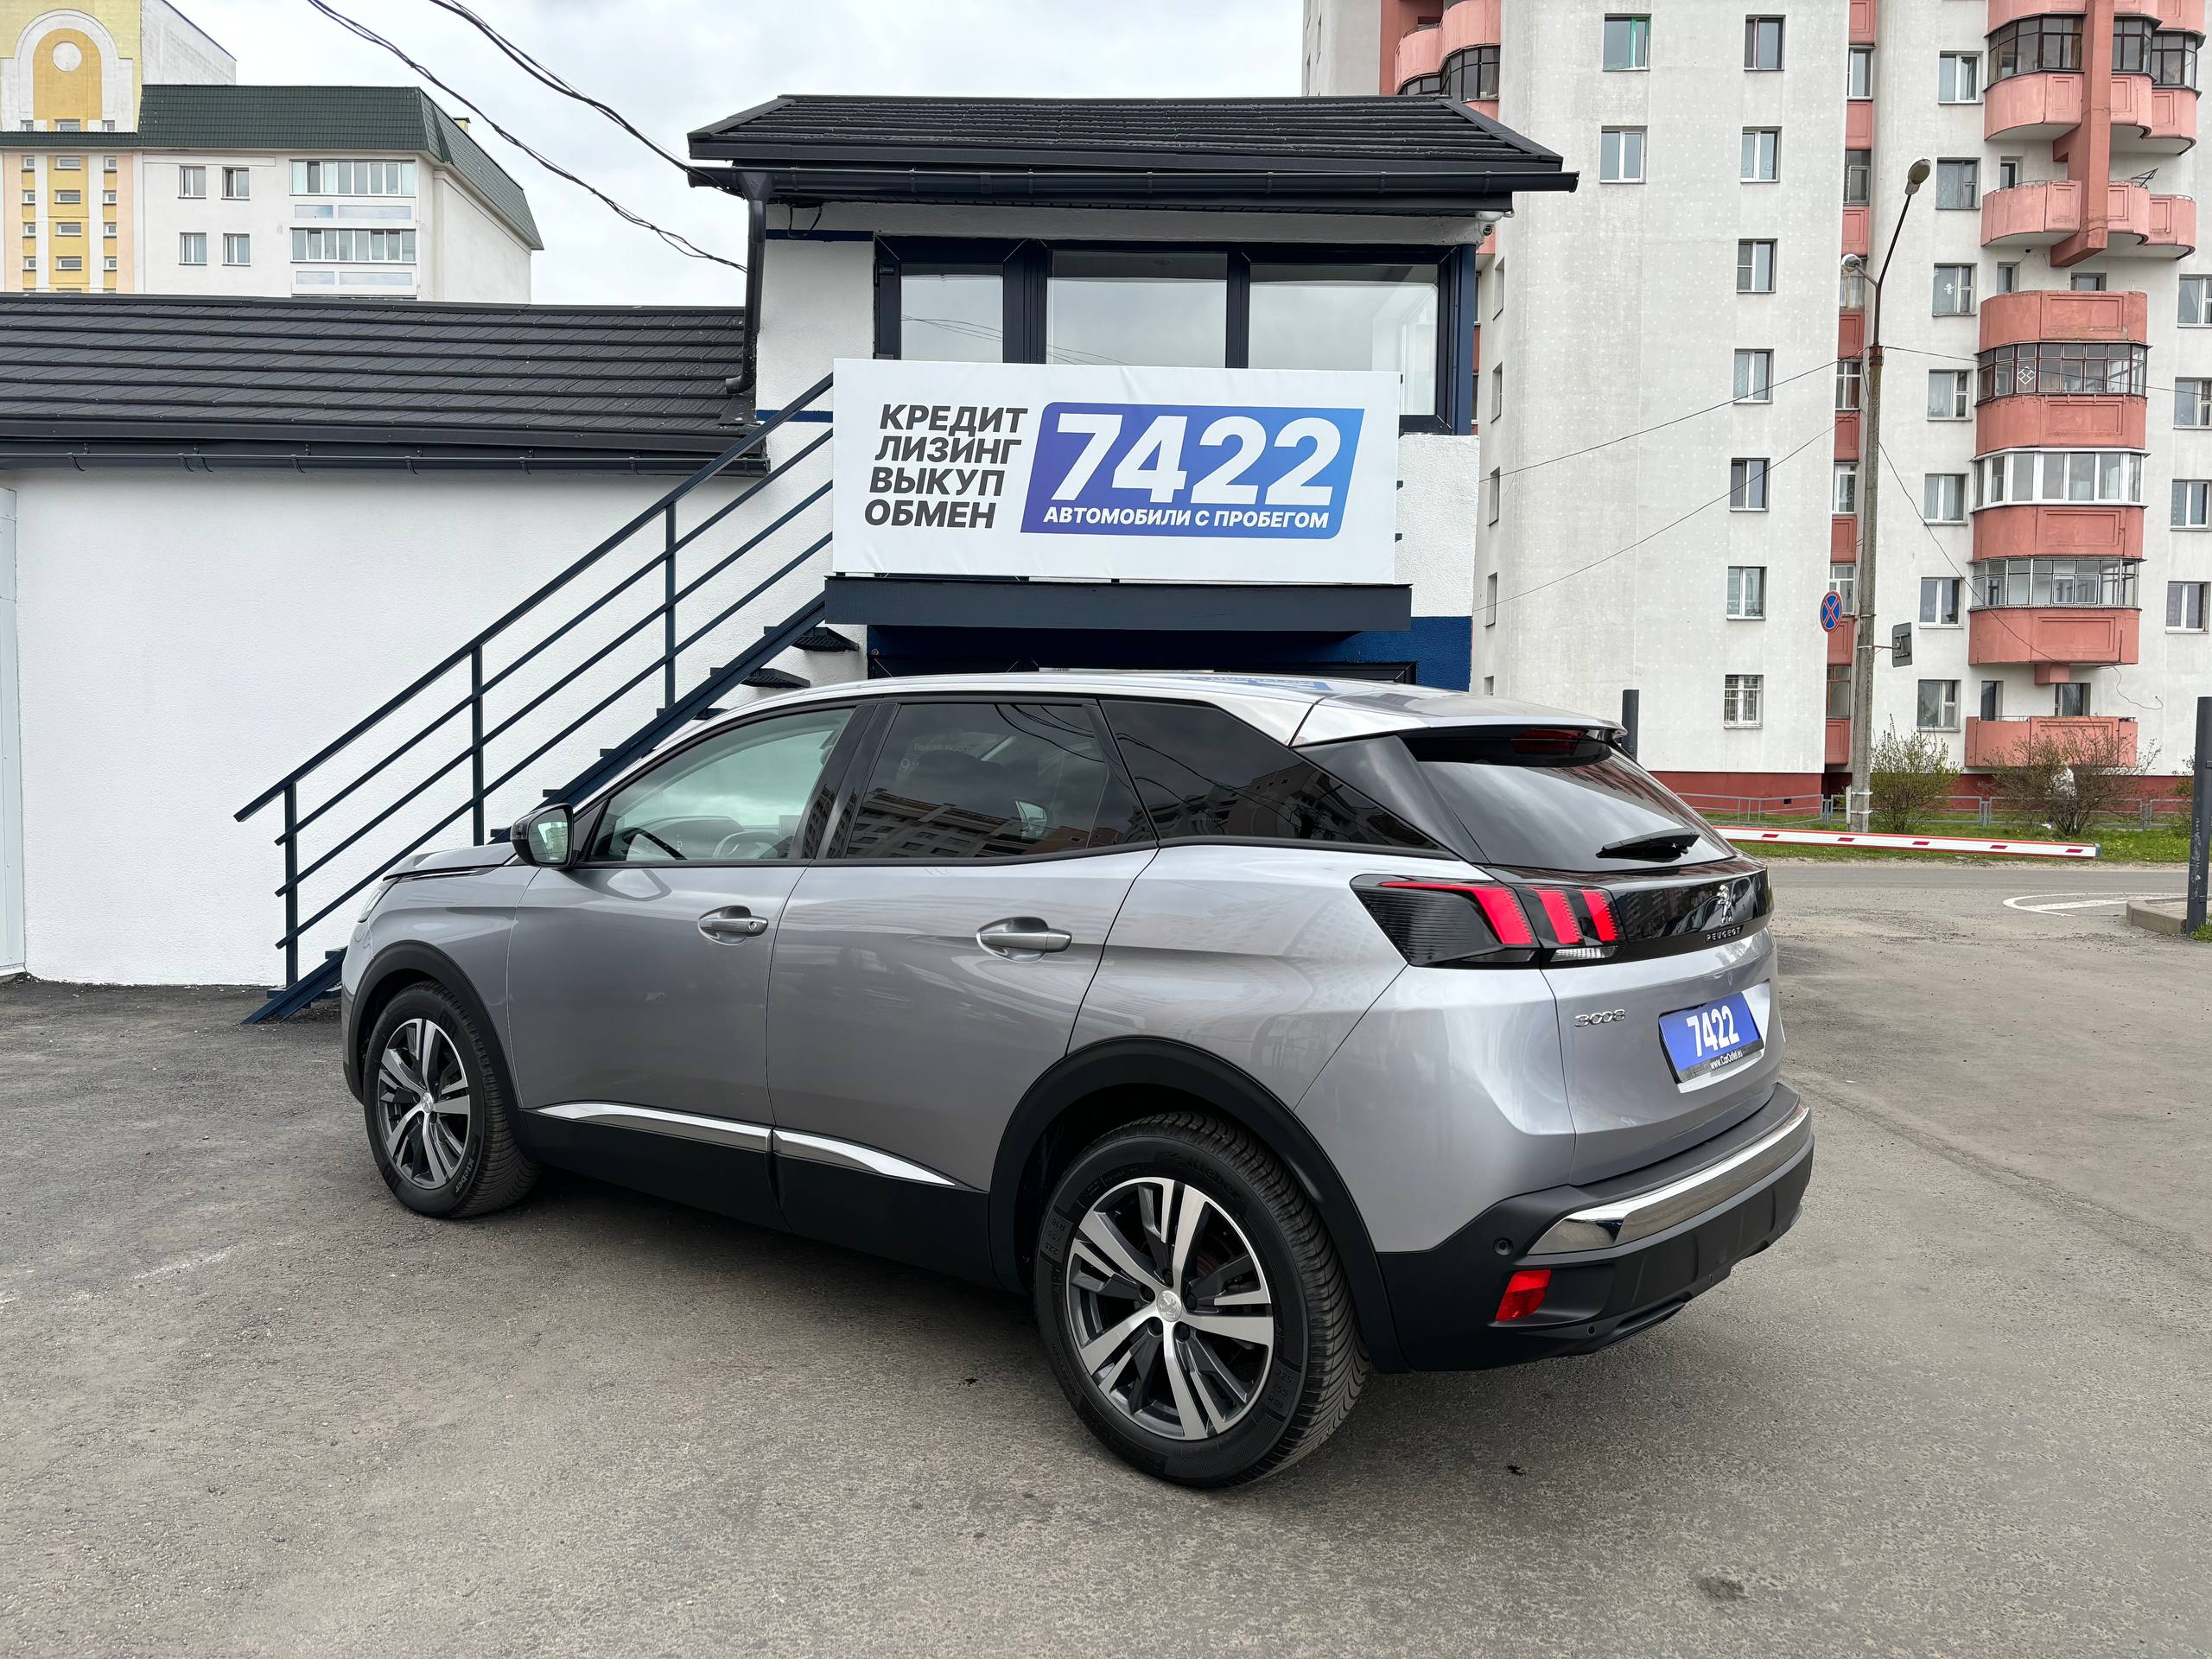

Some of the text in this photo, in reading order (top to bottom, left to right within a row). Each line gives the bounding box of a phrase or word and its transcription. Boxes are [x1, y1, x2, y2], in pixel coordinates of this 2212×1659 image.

[879, 404, 1028, 437] КРЕДИТ
[874, 435, 1022, 465] ЛИЗИНГ
[1051, 412, 1341, 506] 7422
[869, 466, 1005, 497] ВЫКУП
[864, 499, 997, 529] ОБМЕН
[1043, 506, 1330, 529] АВТОМОБИЛИ С ПРОБЕГОМ
[1706, 926, 1741, 942] PEUGEOT
[1574, 1008, 1625, 1027] 3008
[1686, 1005, 1740, 1057] 7422
